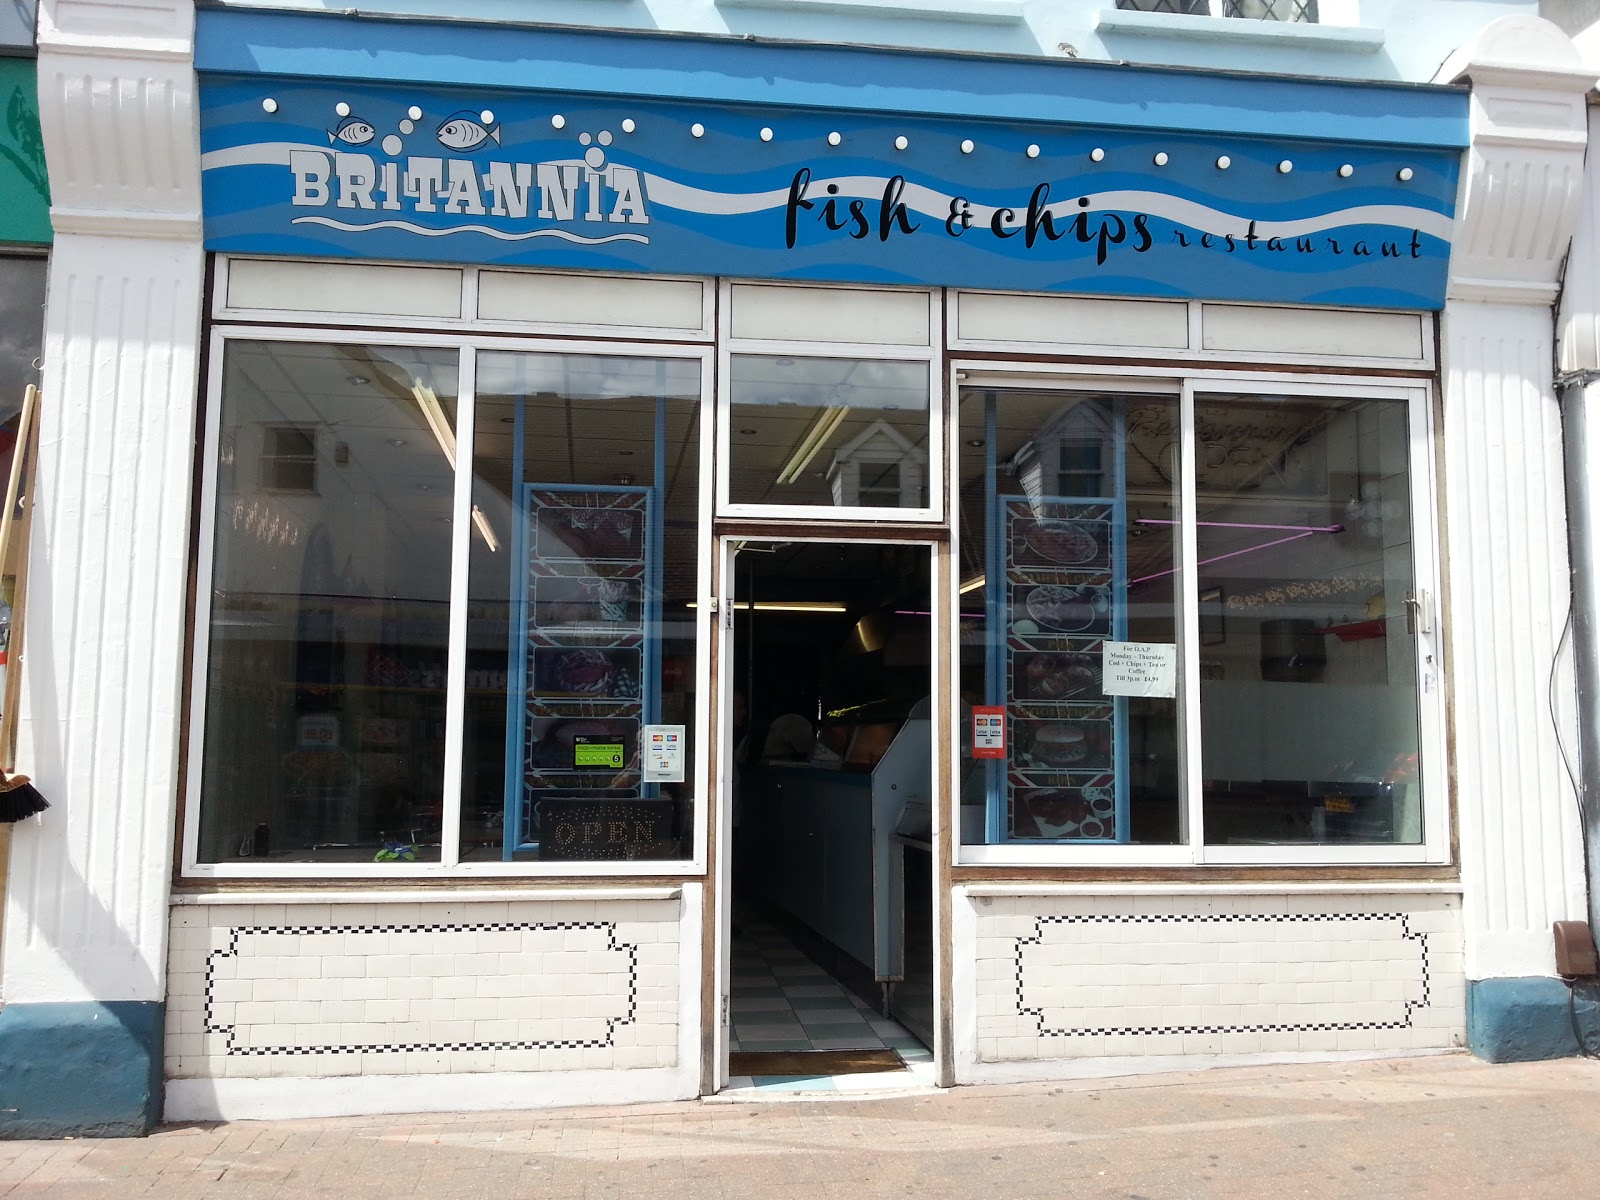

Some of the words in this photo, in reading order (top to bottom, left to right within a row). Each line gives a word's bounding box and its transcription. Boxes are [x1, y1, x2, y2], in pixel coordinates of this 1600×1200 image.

[786, 167, 921, 249] fish
[946, 196, 974, 236] &
[991, 182, 1153, 266] chips
[1172, 220, 1423, 259] restaurant
[555, 821, 655, 845] OPEN
